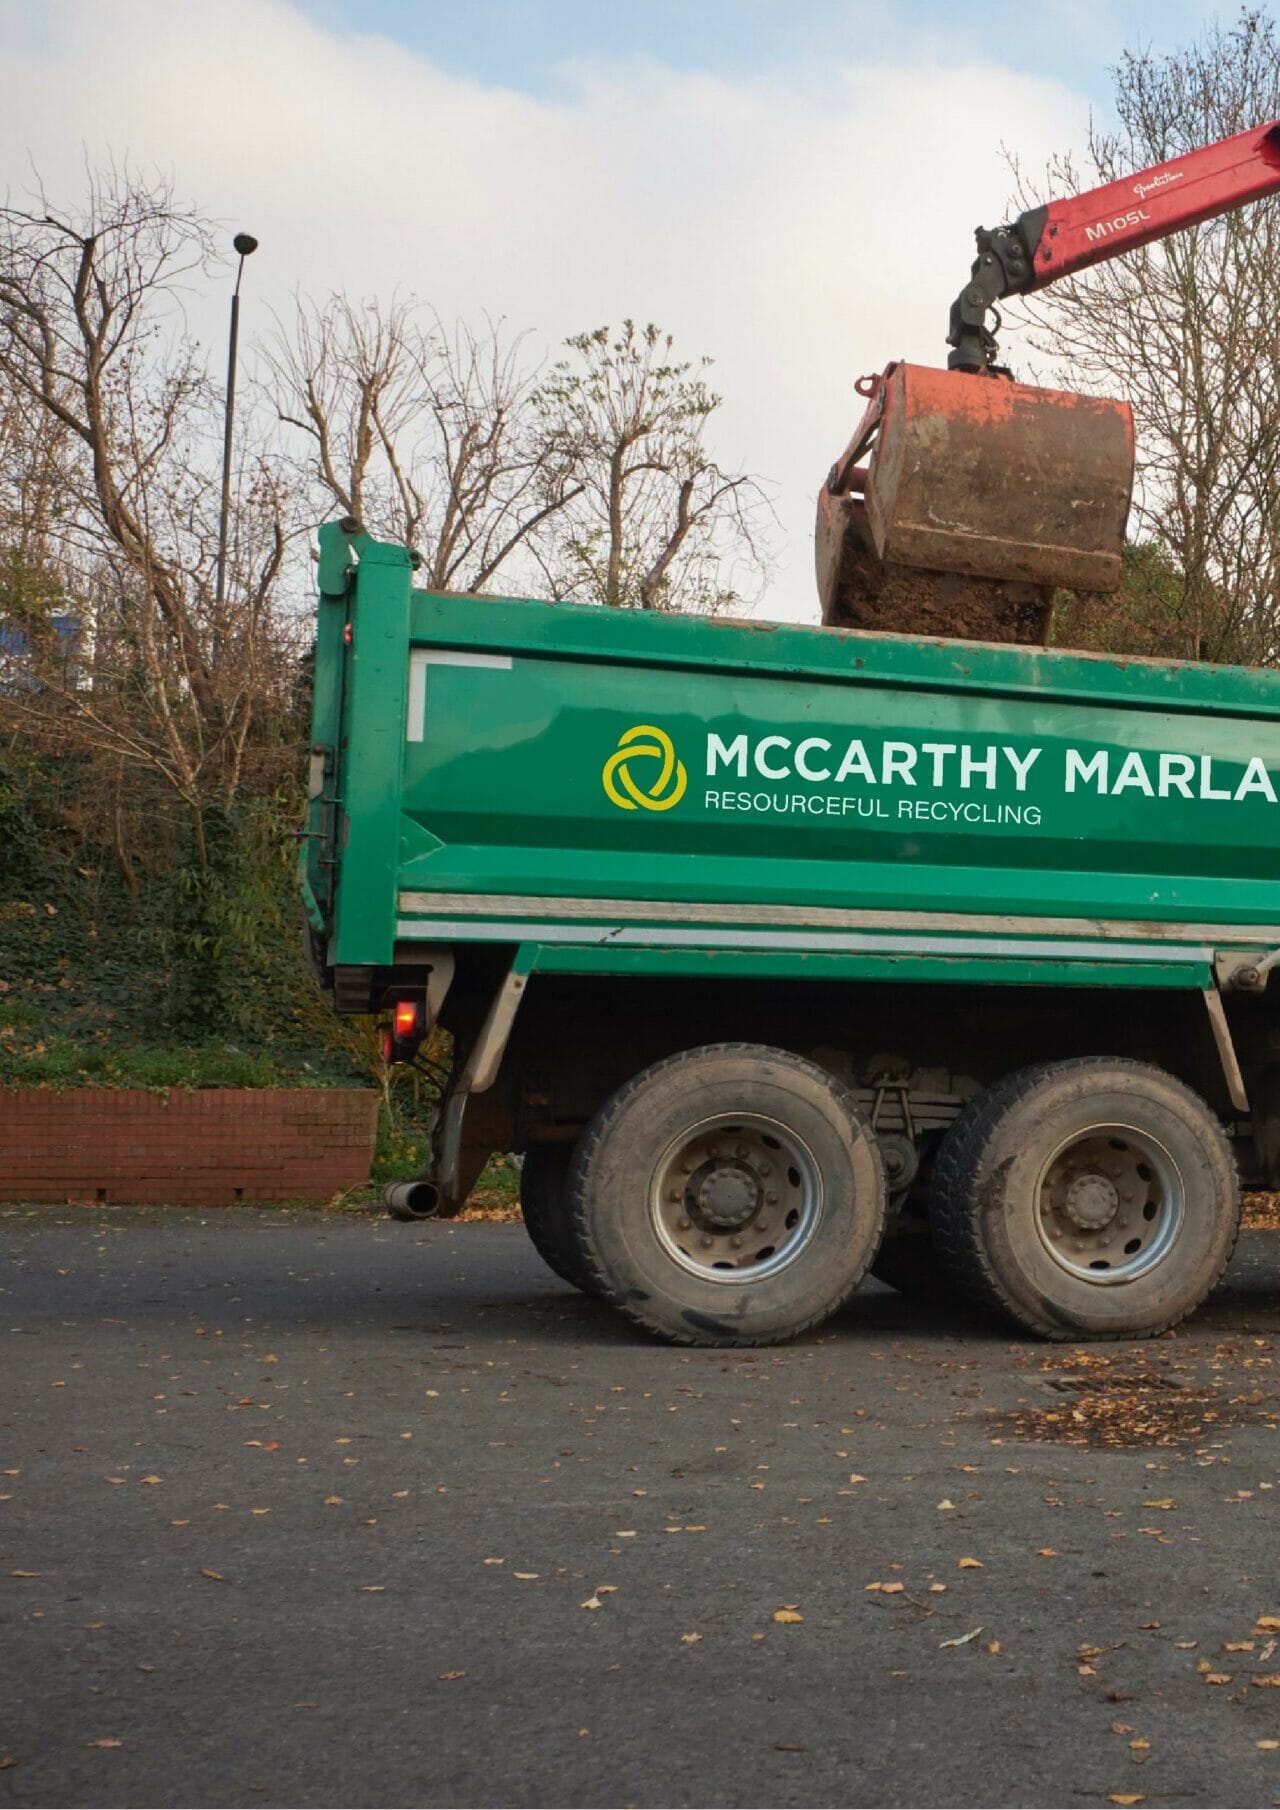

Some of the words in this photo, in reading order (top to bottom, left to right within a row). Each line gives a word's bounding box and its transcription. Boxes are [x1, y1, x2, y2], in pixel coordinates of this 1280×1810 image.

[1085, 209, 1151, 241] M105L
[705, 733, 1043, 791] MCCARTHY
[705, 790, 890, 818] RESOURCEFUL
[898, 800, 1042, 826] RECYCLING
